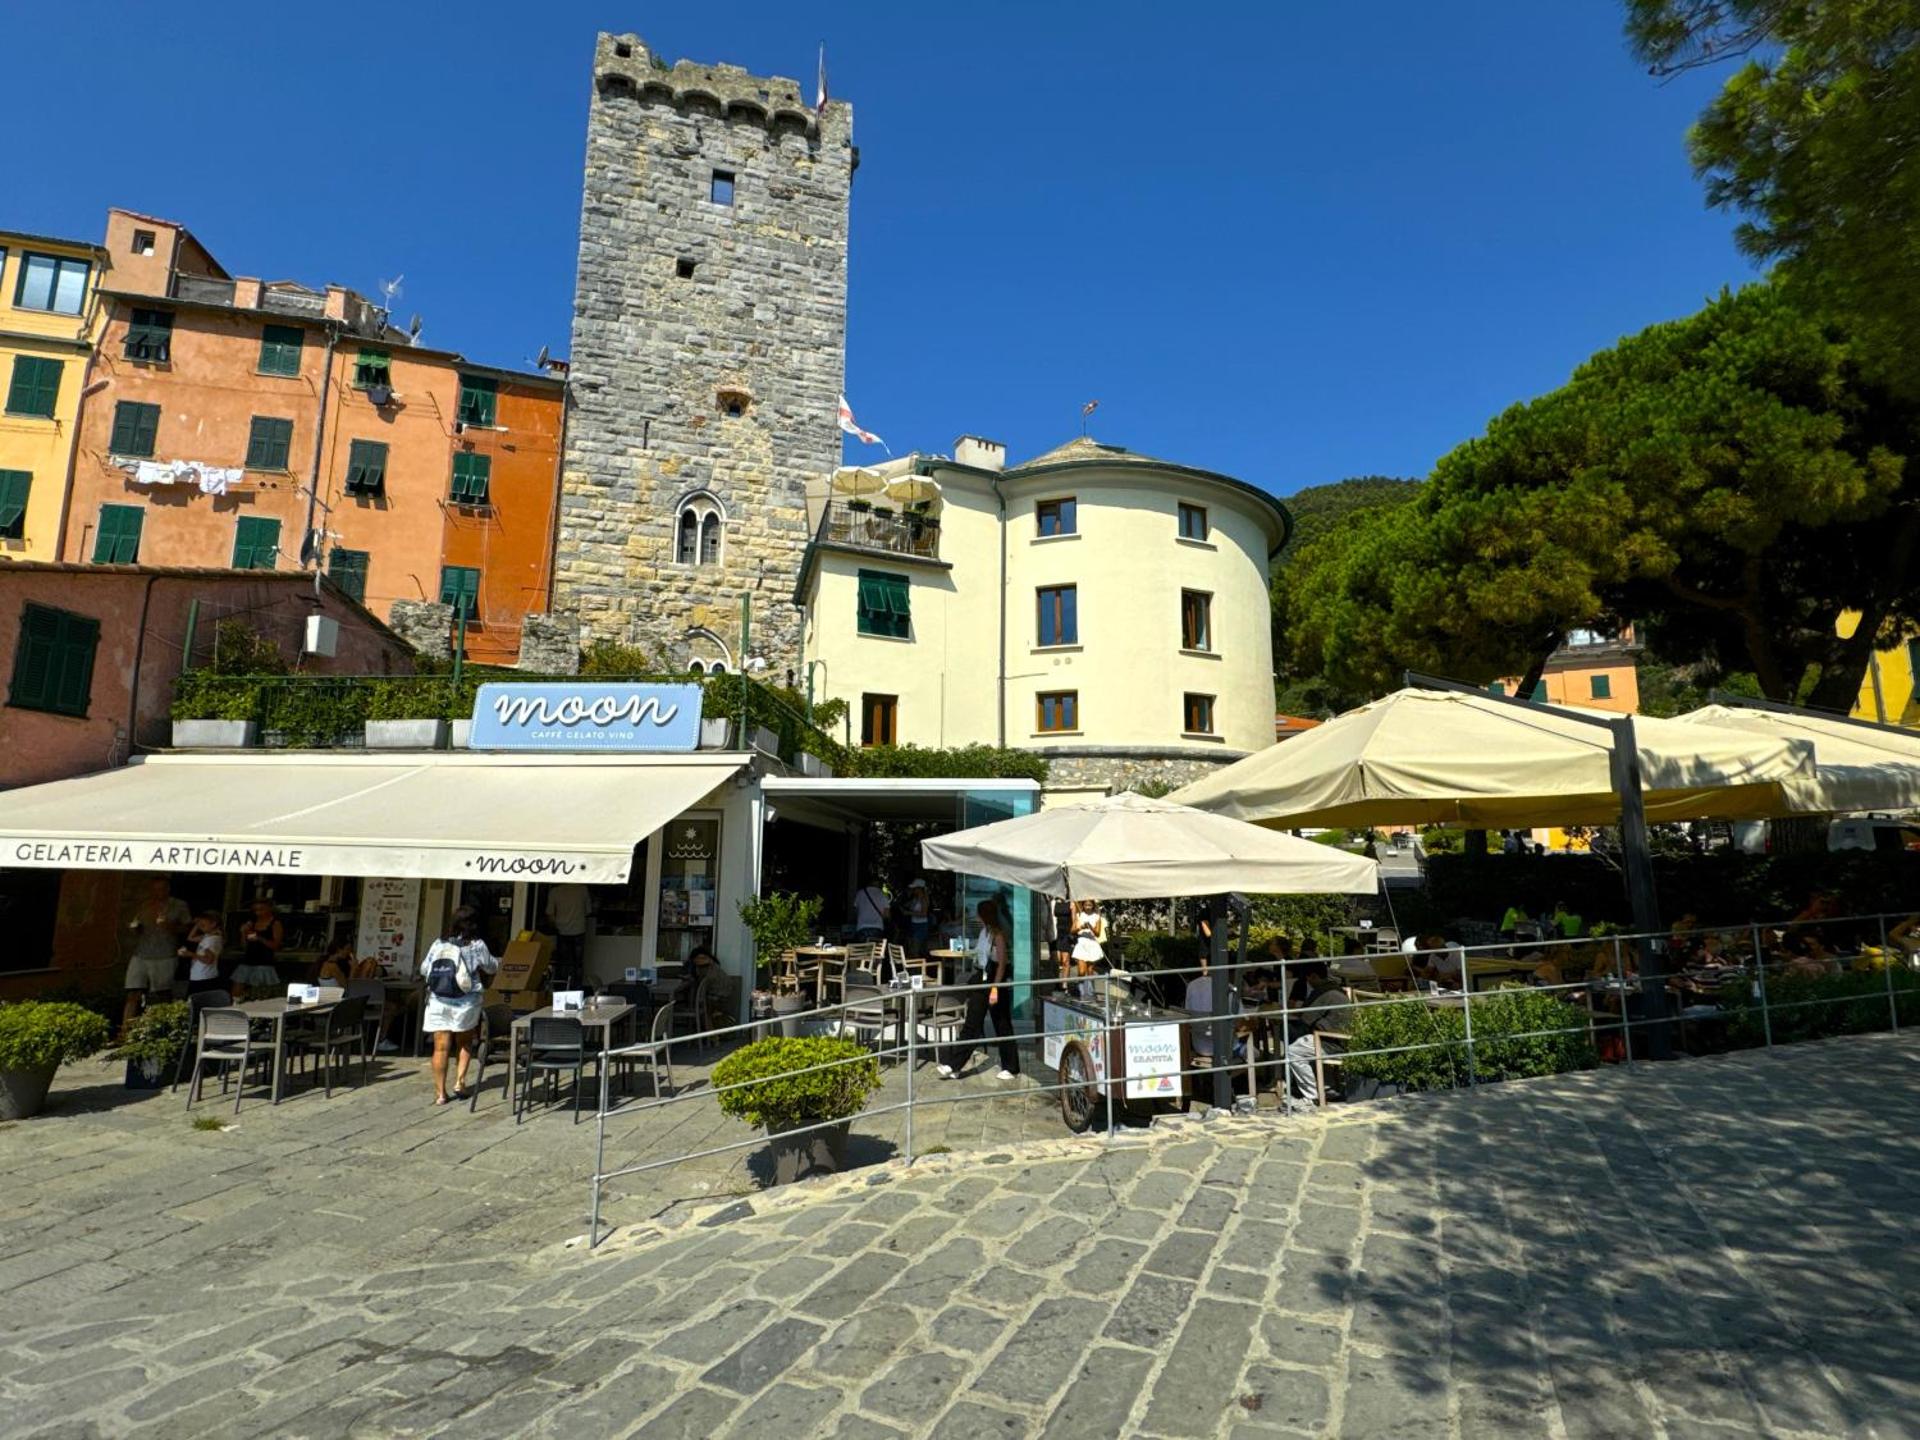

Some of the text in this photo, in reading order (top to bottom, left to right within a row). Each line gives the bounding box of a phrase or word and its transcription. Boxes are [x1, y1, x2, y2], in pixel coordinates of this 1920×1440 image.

[494, 694, 678, 727] moon
[566, 731, 604, 739] GELATO
[15, 843, 303, 867] GELATERIA ARTIGIANALE
[1128, 1044, 1177, 1053] moon
